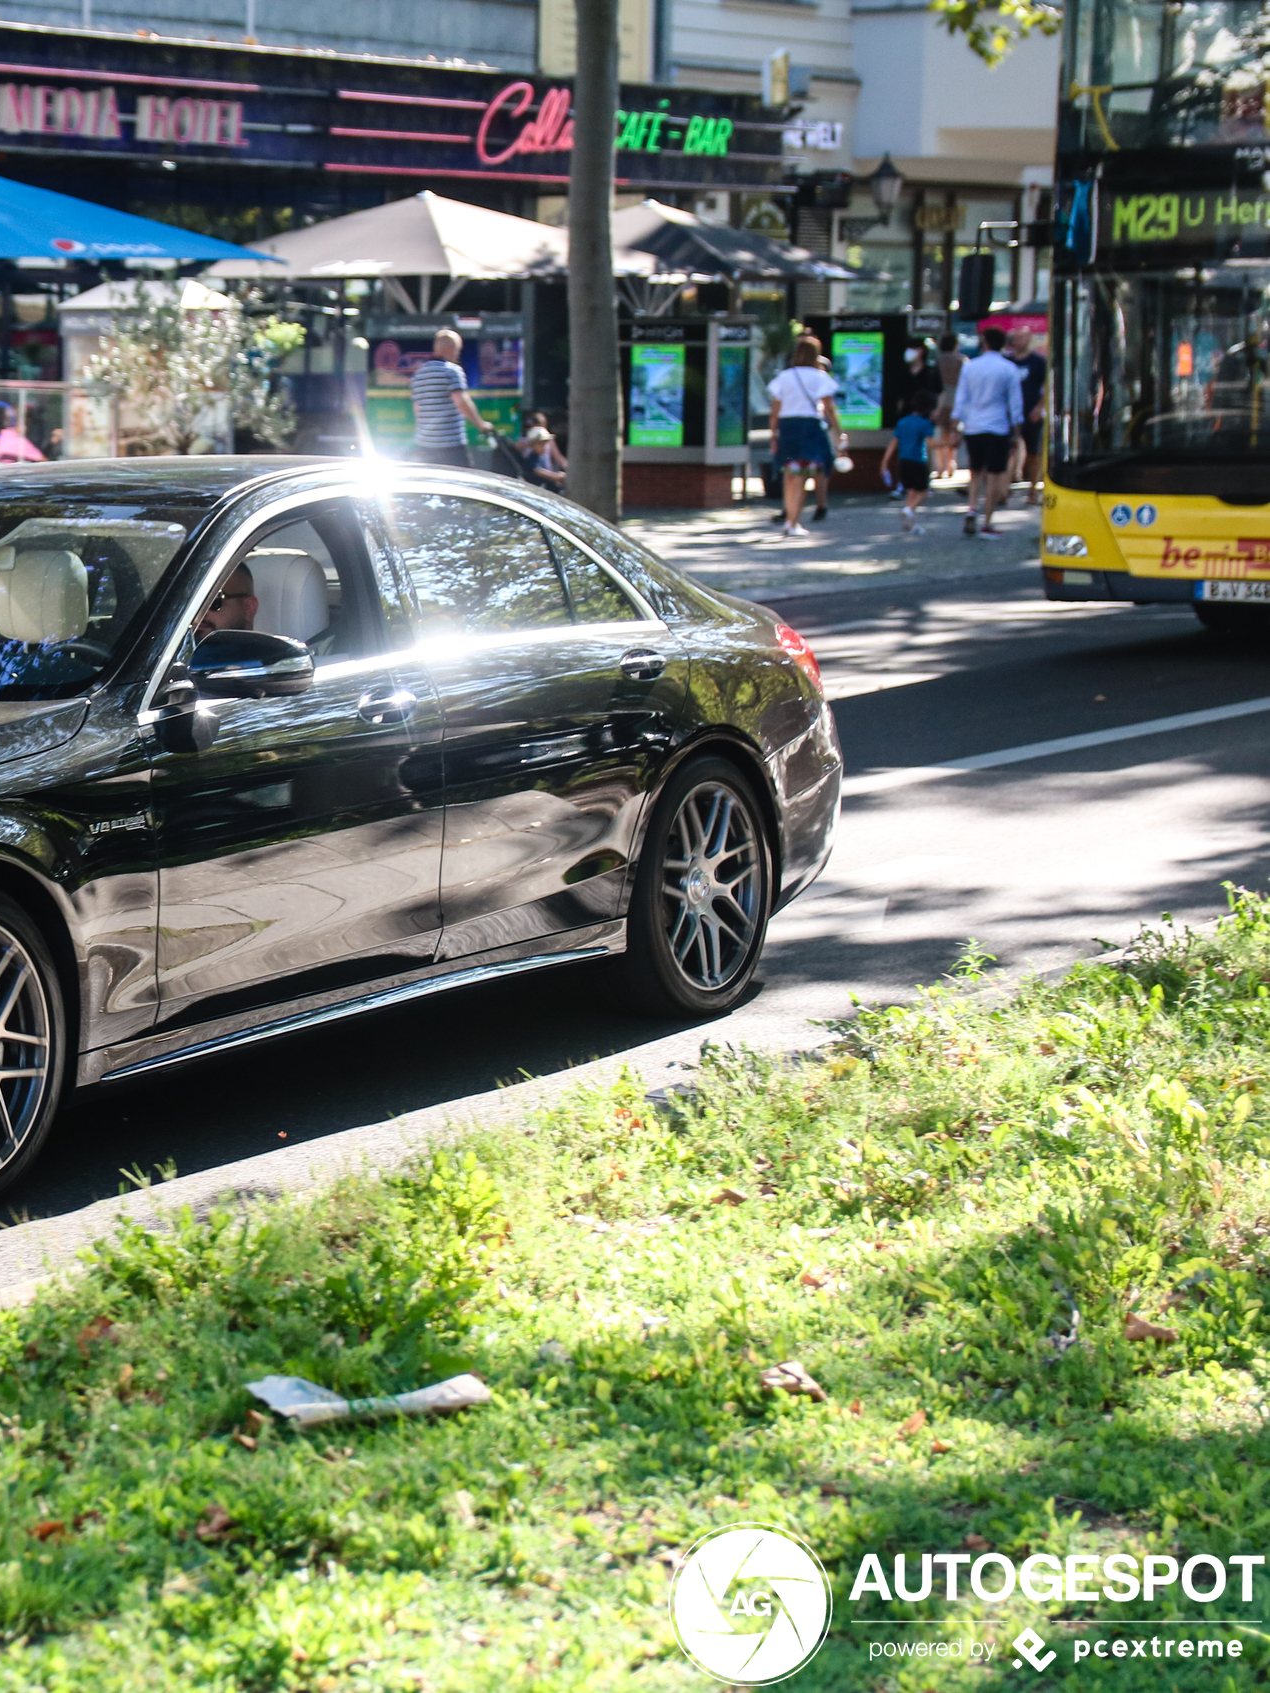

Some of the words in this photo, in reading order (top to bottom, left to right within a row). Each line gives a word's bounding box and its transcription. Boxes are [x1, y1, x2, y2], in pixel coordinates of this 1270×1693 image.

[135, 95, 250, 147] HOTEL
[1112, 193, 1180, 244] M29
[1183, 197, 1206, 227] U
[1214, 195, 1270, 225] Her
